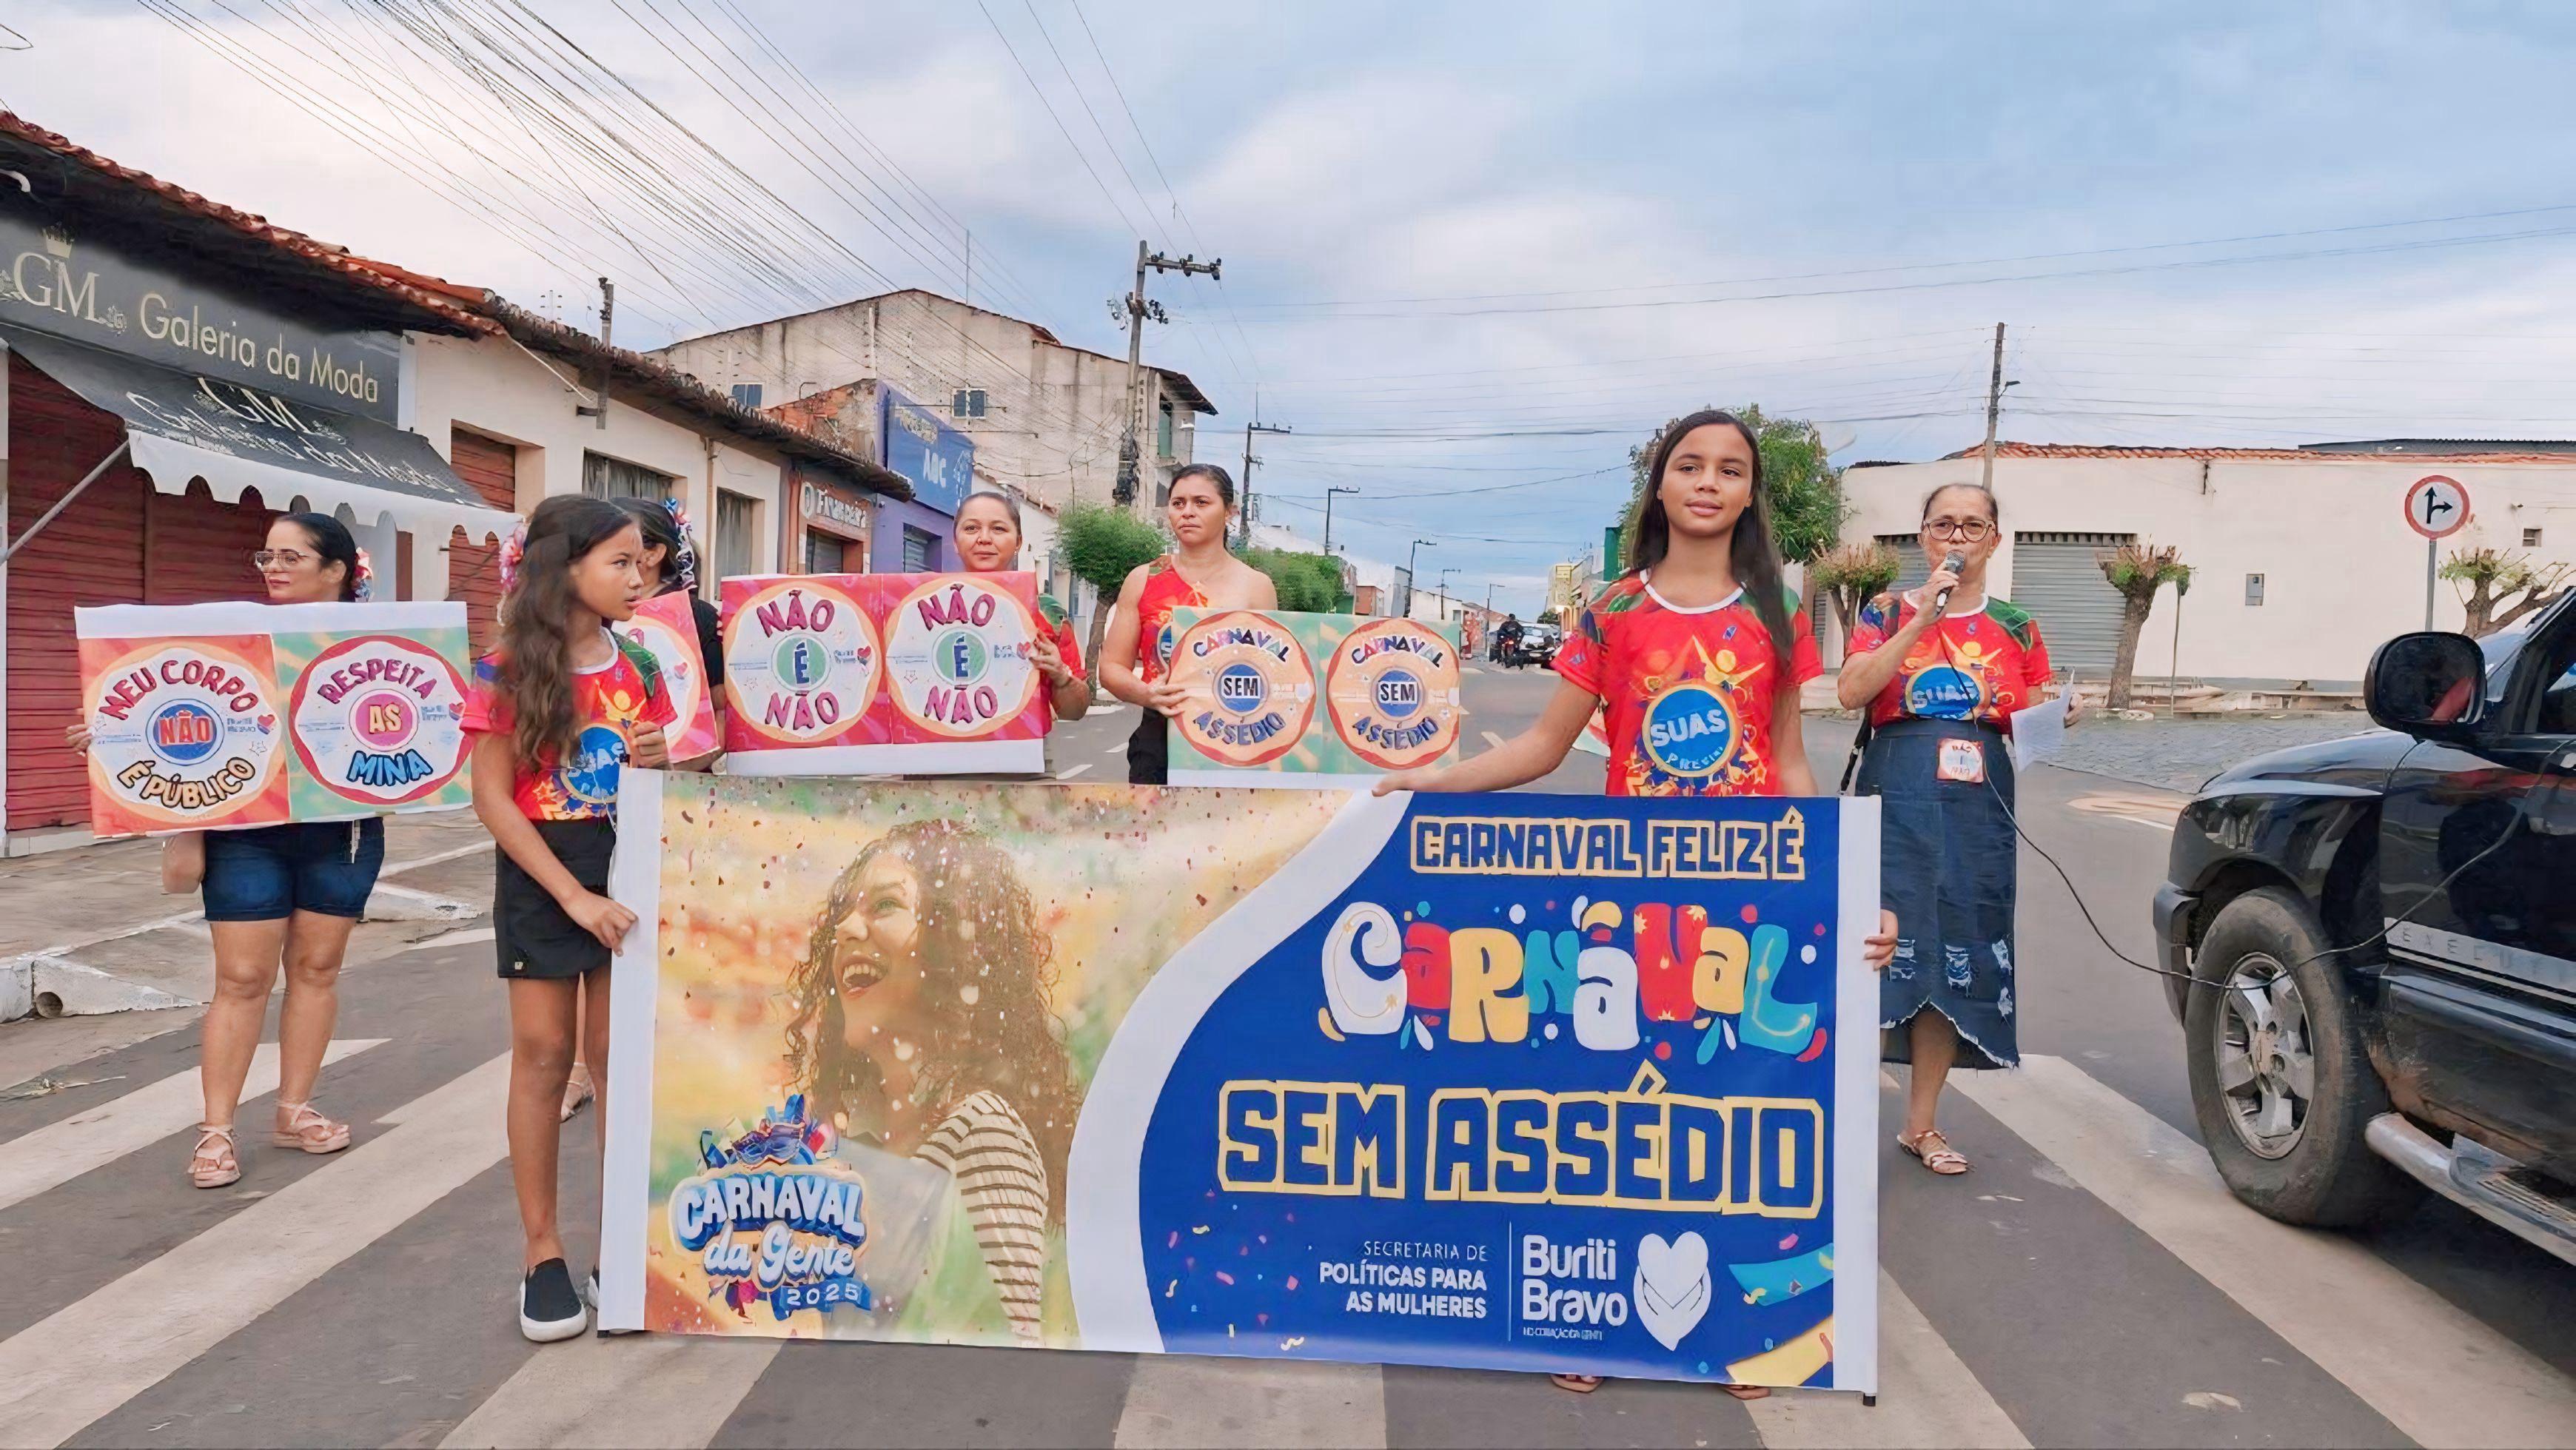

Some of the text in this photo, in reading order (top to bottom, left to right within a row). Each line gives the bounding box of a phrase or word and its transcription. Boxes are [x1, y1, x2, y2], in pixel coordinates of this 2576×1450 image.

[14, 252, 101, 323] GM
[139, 293, 379, 403] Galeria da Moda
[756, 589, 836, 638] NÃO
[917, 584, 996, 631] NÃO
[794, 642, 811, 685] É
[953, 635, 970, 679] É
[1193, 627, 1290, 663] CARNAVAL
[1351, 634, 1444, 668] CARNAVAL
[98, 659, 260, 721] MEU CORPO
[317, 659, 438, 705] RESPEITA
[1223, 677, 1259, 697] SEM
[1380, 681, 1417, 702] SEM
[369, 702, 403, 734] AS
[765, 690, 840, 731] NÃO
[923, 684, 999, 725] NÃO
[156, 709, 214, 748] NÃO
[1650, 708, 1727, 748] SUAS
[139, 756, 256, 809] PÚBLICO
[346, 749, 433, 788] MINA
[1411, 816, 1643, 878] CARNAVAL
[1647, 819, 1768, 881] FELIZ
[1218, 1058, 1823, 1219] SEM ASSÉDIO
[677, 1172, 868, 1252] CARNAVAL
[703, 1221, 856, 1288] da Gente
[1364, 1240, 1487, 1262] SECRETARIA DE
[1523, 1234, 1617, 1281] Buriti
[786, 1283, 862, 1307] 2025
[1319, 1259, 1487, 1291] POLÍTICAS PARA
[1346, 1291, 1487, 1319] AS MULHERES
[1523, 1278, 1629, 1327] Bravo
